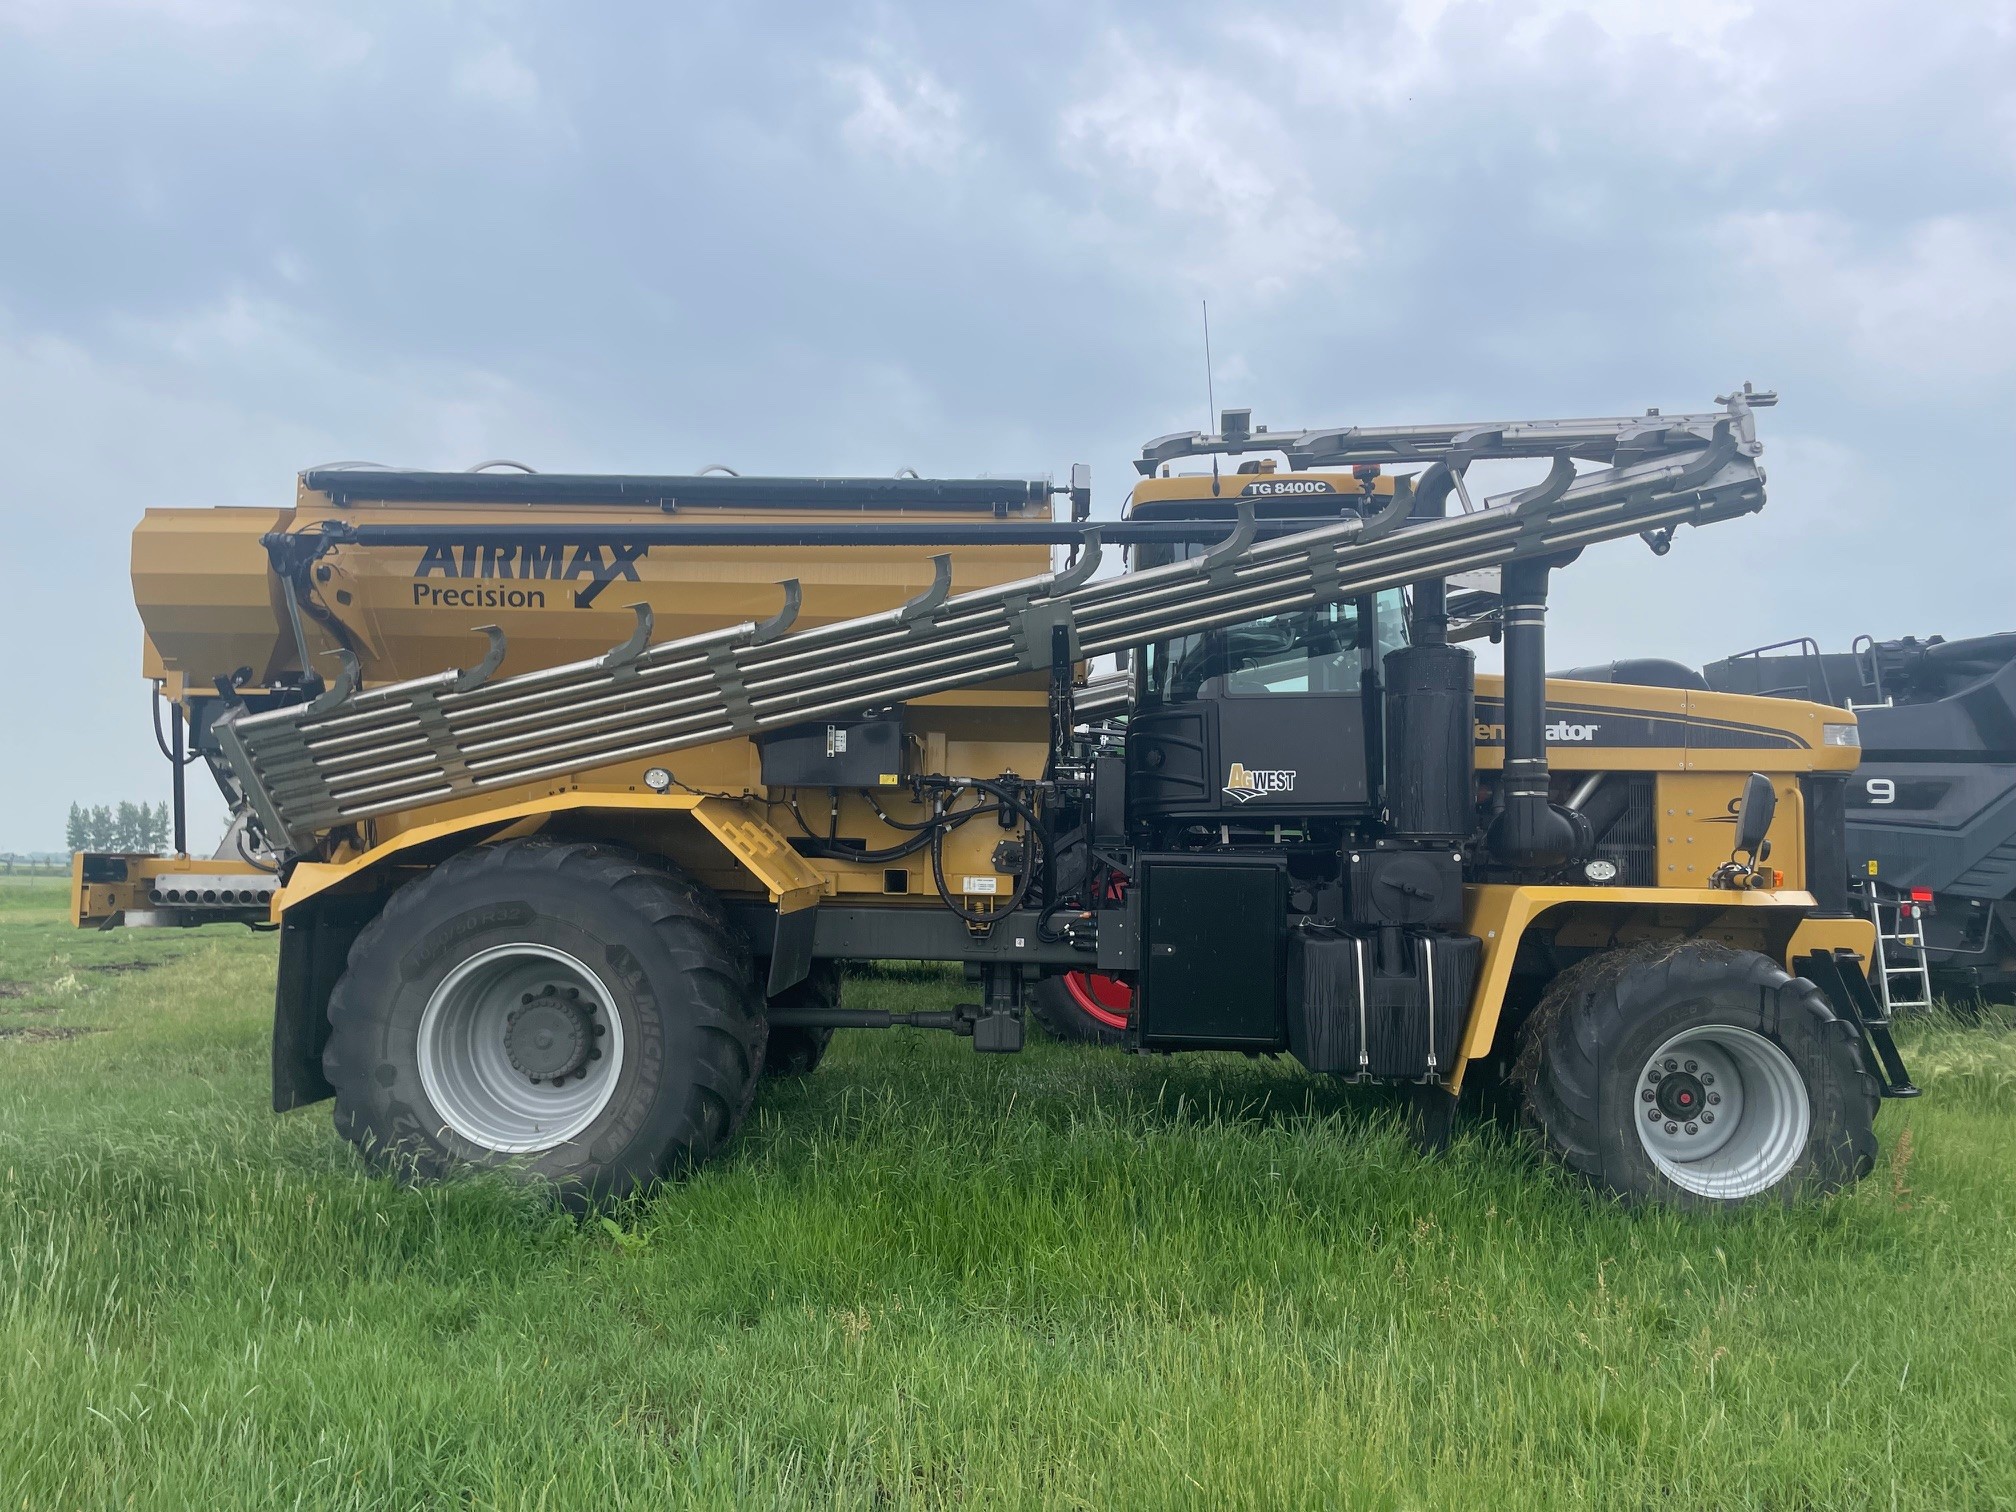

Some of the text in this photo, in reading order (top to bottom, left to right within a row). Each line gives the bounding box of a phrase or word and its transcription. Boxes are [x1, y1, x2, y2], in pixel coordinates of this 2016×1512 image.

[1249, 481, 1327, 495] TG 8400C
[413, 545, 649, 582] AIRMAX
[413, 583, 545, 608] Precision
[1866, 778, 1895, 804] 9
